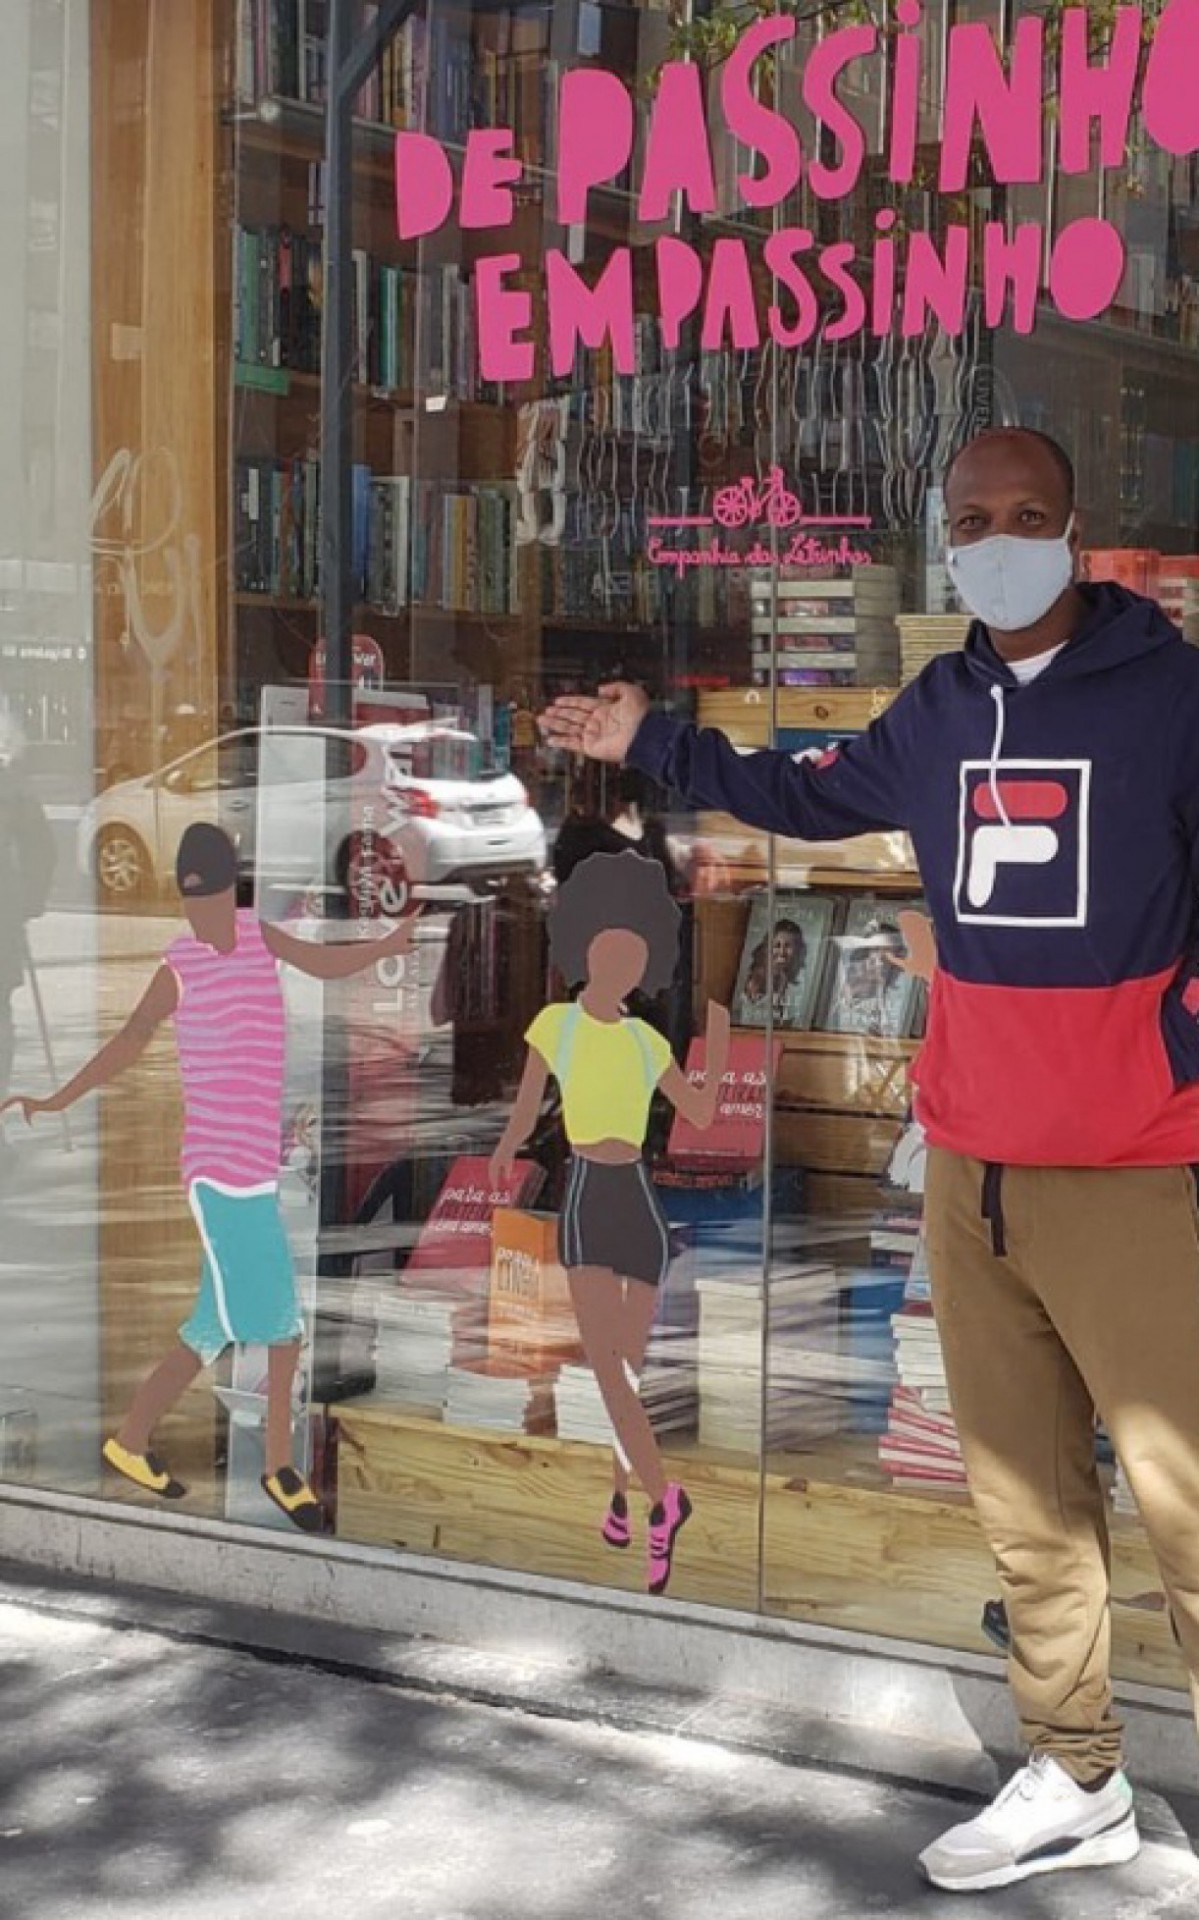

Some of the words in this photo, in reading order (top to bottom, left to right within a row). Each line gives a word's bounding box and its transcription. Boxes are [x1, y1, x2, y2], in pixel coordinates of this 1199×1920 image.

[396, 128, 523, 240] DE
[475, 248, 635, 382] EM
[648, 535, 742, 580] Companhia
